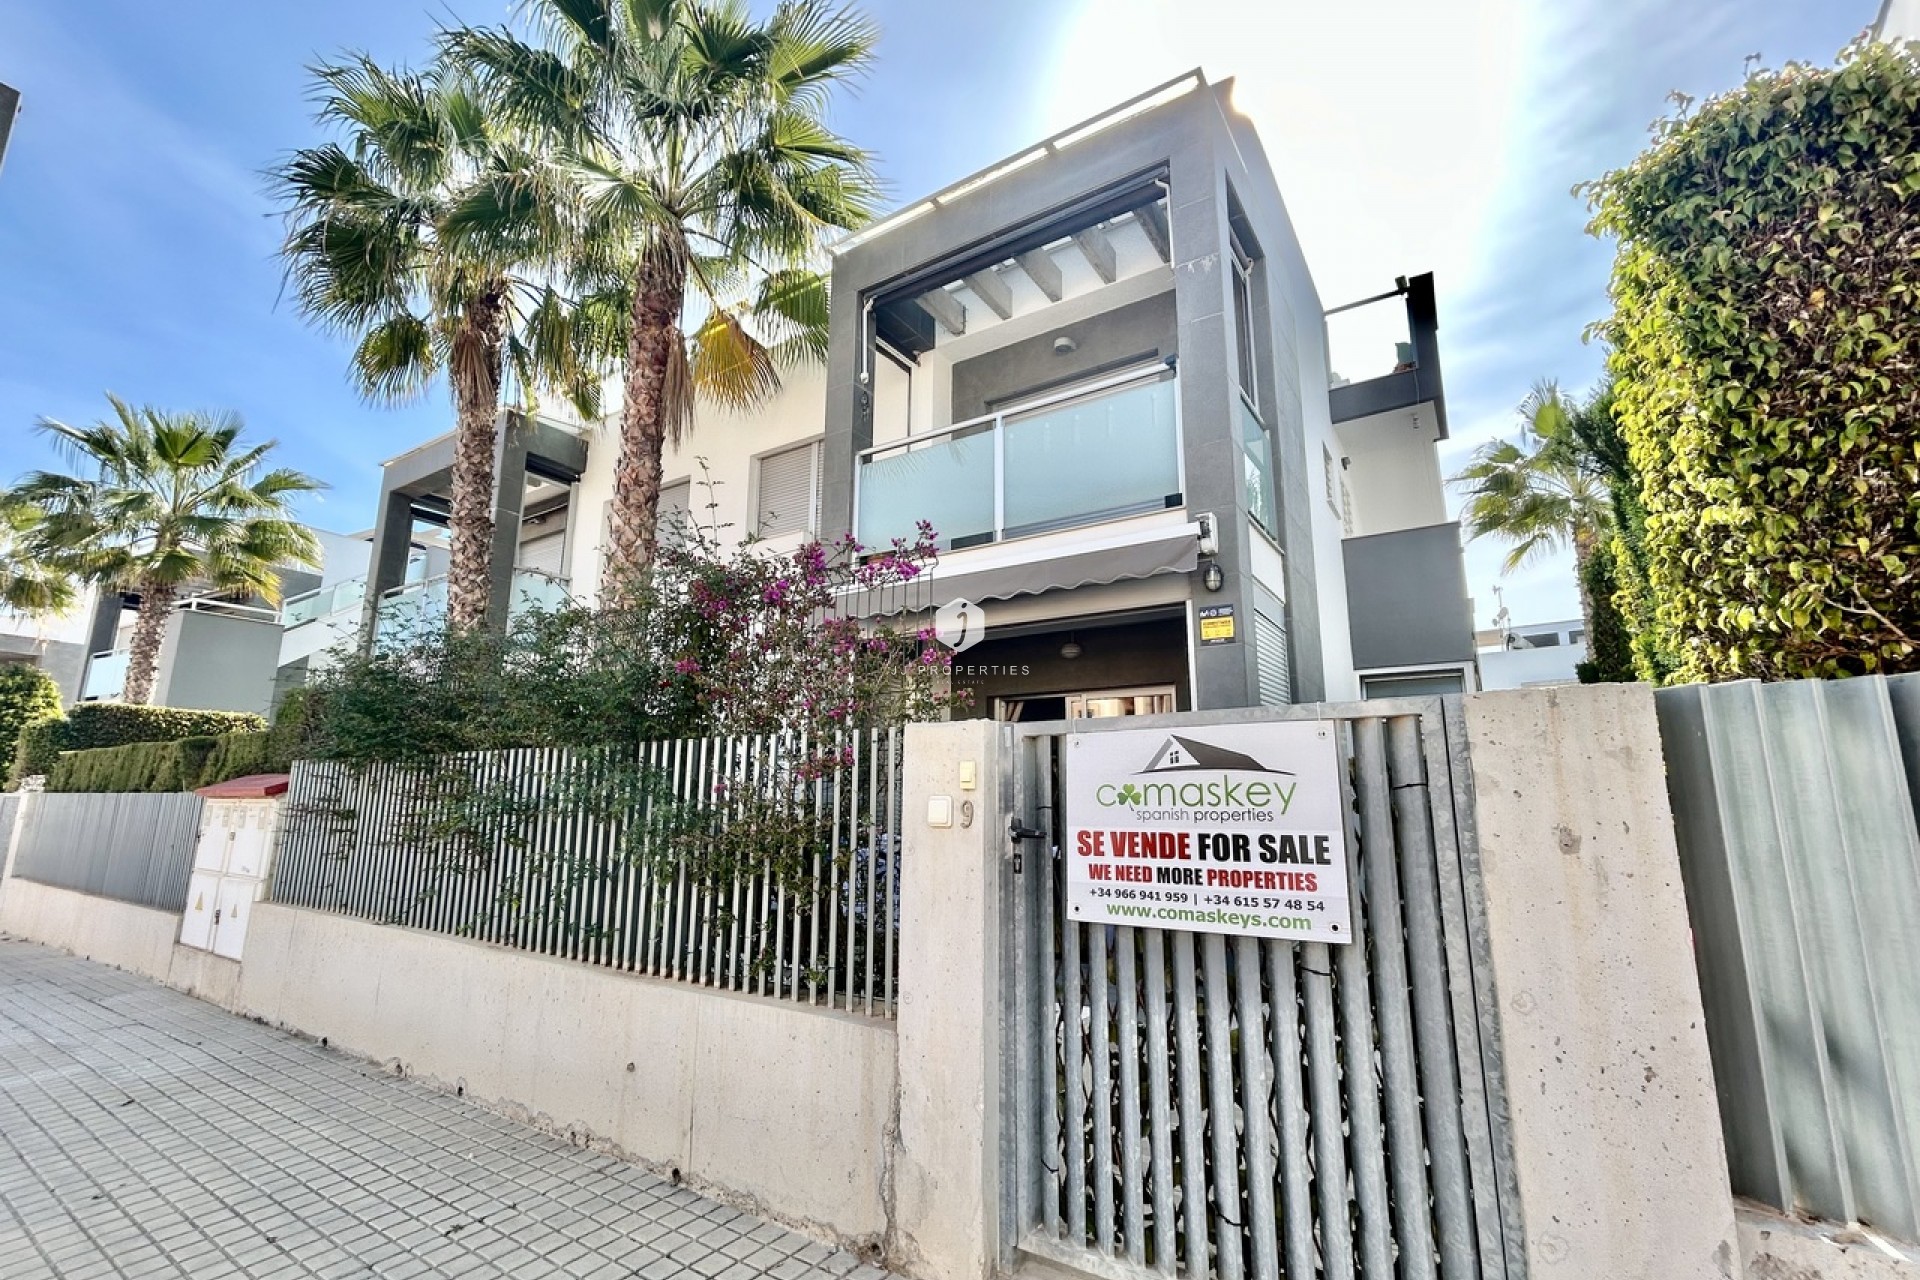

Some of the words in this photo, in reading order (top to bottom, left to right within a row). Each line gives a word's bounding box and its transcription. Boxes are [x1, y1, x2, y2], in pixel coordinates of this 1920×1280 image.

[960, 800, 974, 829] 9
[1136, 807, 1190, 822] spanish
[1193, 808, 1274, 823] properties
[1076, 829, 1106, 857] SE
[1109, 831, 1192, 860] VENDE
[1197, 833, 1252, 862] FOR
[1258, 833, 1332, 866] SALE
[1088, 863, 1112, 881] WE
[1115, 864, 1153, 883] NEED
[1156, 866, 1203, 886] MORE
[1206, 868, 1318, 893] PROPERTIES
[1090, 887, 1112, 898] +34
[1114, 889, 1137, 900] 966
[1139, 890, 1161, 901] 941
[1164, 891, 1189, 903] 959
[1204, 894, 1231, 906] +34
[1233, 896, 1260, 908] 615
[1262, 898, 1280, 910] 57
[1284, 899, 1303, 911] 48
[1307, 900, 1326, 912] 54
[1106, 903, 1312, 930] www.comaskeys.com
